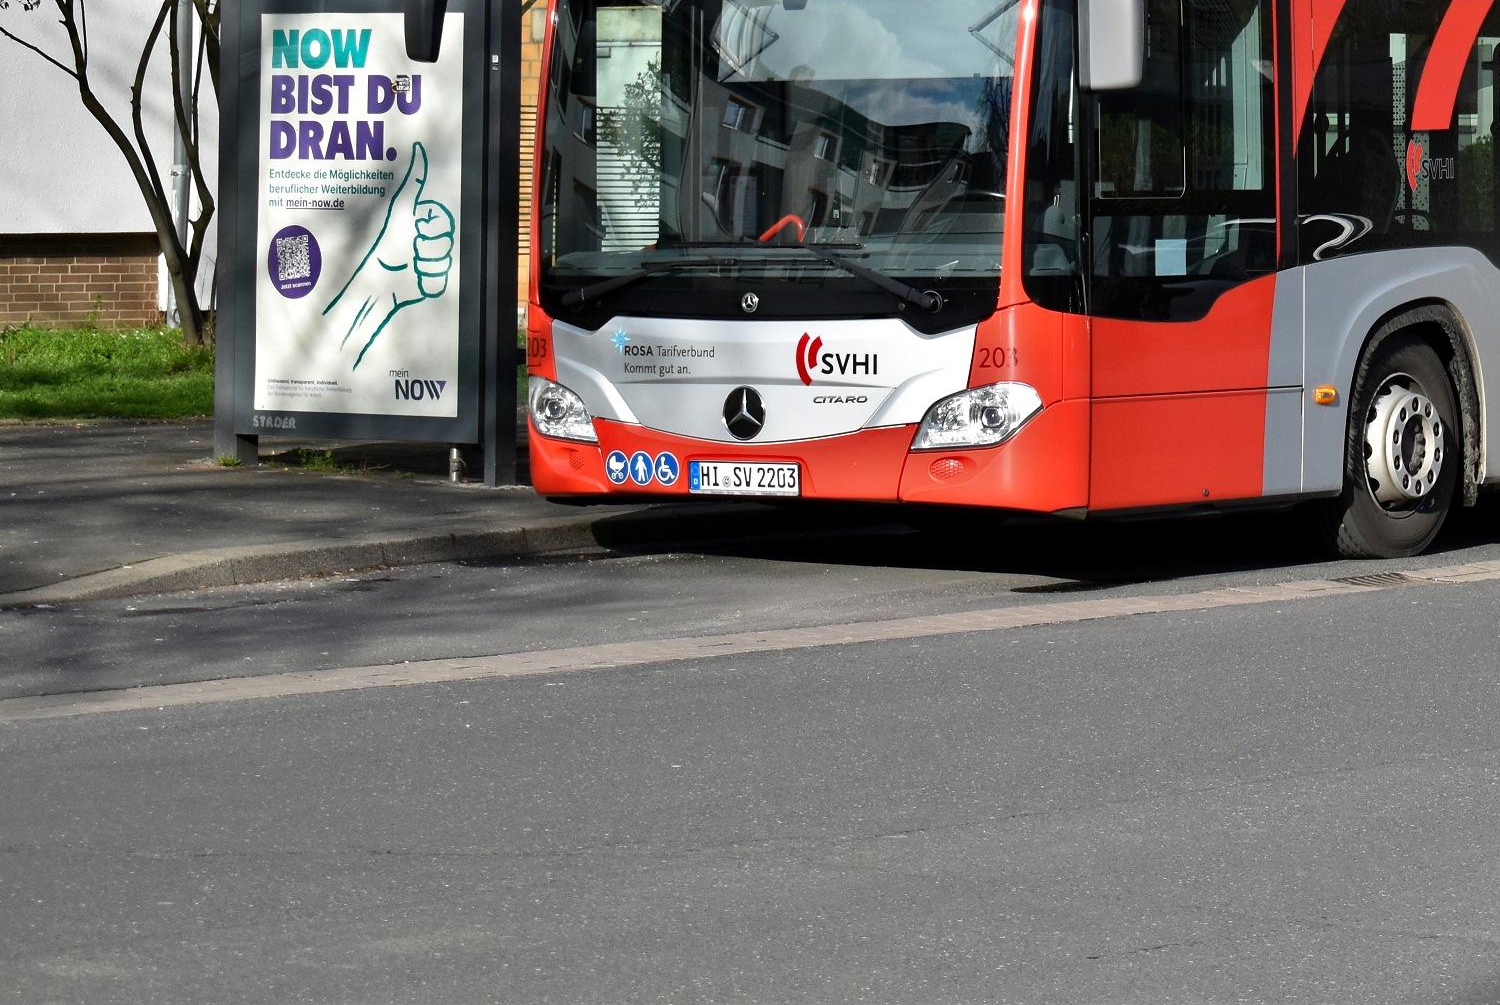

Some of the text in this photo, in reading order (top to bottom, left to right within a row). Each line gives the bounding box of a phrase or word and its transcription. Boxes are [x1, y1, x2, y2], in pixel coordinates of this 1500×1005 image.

[271, 28, 373, 70] NOW
[270, 73, 355, 116] BIST
[366, 74, 422, 116] DU
[269, 120, 398, 162] DRAN.
[269, 169, 395, 182] Entdecke die Möglichkeiten
[1421, 157, 1455, 180] SVHI
[269, 183, 386, 197] beruflicher Weiterbildung
[268, 197, 345, 208] mit mein-now.de
[624, 344, 715, 358] ROSA Tarifverbund
[624, 362, 691, 377] Kommt gut an.
[820, 352, 878, 375] SVHI
[389, 368, 409, 378] mein
[395, 379, 447, 401] NOW
[813, 396, 868, 404] CITARO
[701, 465, 796, 489] HI SV 2203
